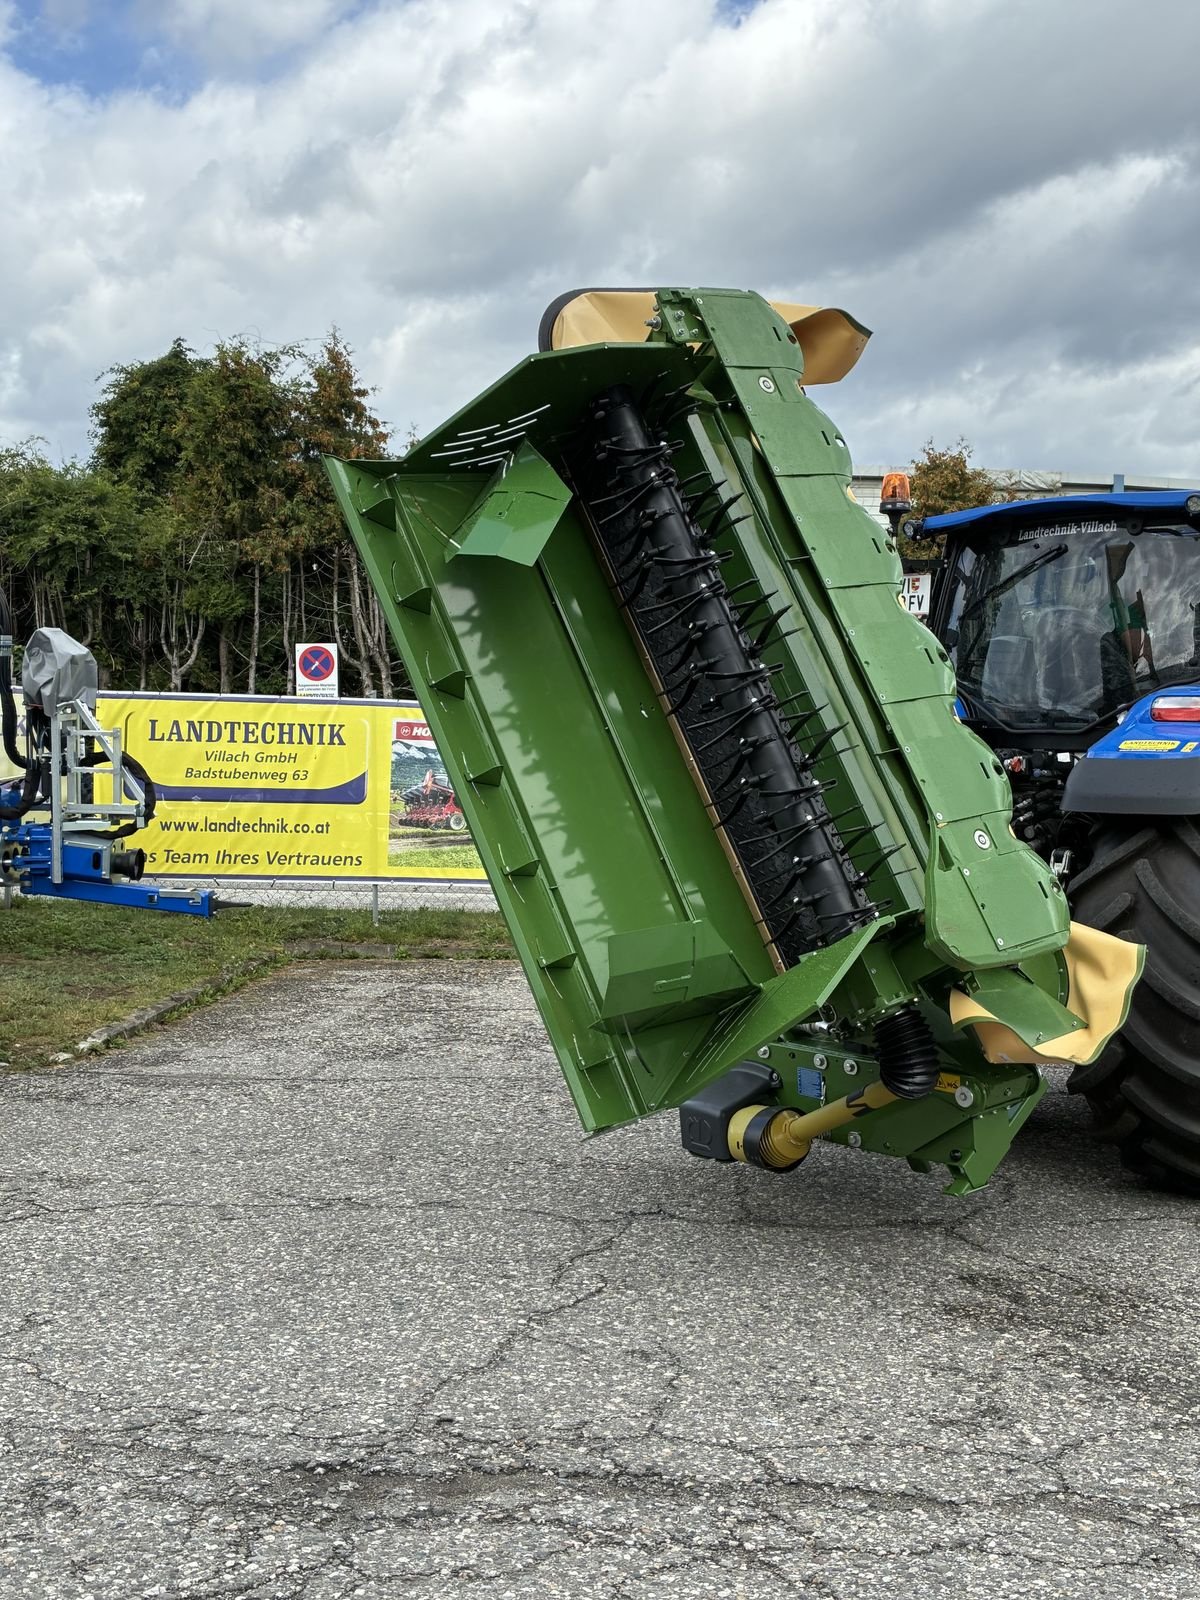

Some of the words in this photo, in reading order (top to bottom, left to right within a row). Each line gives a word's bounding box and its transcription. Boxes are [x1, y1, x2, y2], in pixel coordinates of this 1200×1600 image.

[1018, 520, 1117, 541] Landtechnik-Villach
[148, 719, 346, 746] LANDTECHNIK
[205, 751, 250, 763] Villach
[254, 751, 298, 763] GmbH
[185, 767, 288, 782] Badstubenweg
[292, 769, 309, 781] 63
[160, 816, 330, 834] www.landtechnik.co.at
[163, 849, 209, 864] Team
[215, 850, 260, 865] Ihres
[266, 850, 363, 866] Vertrauens
